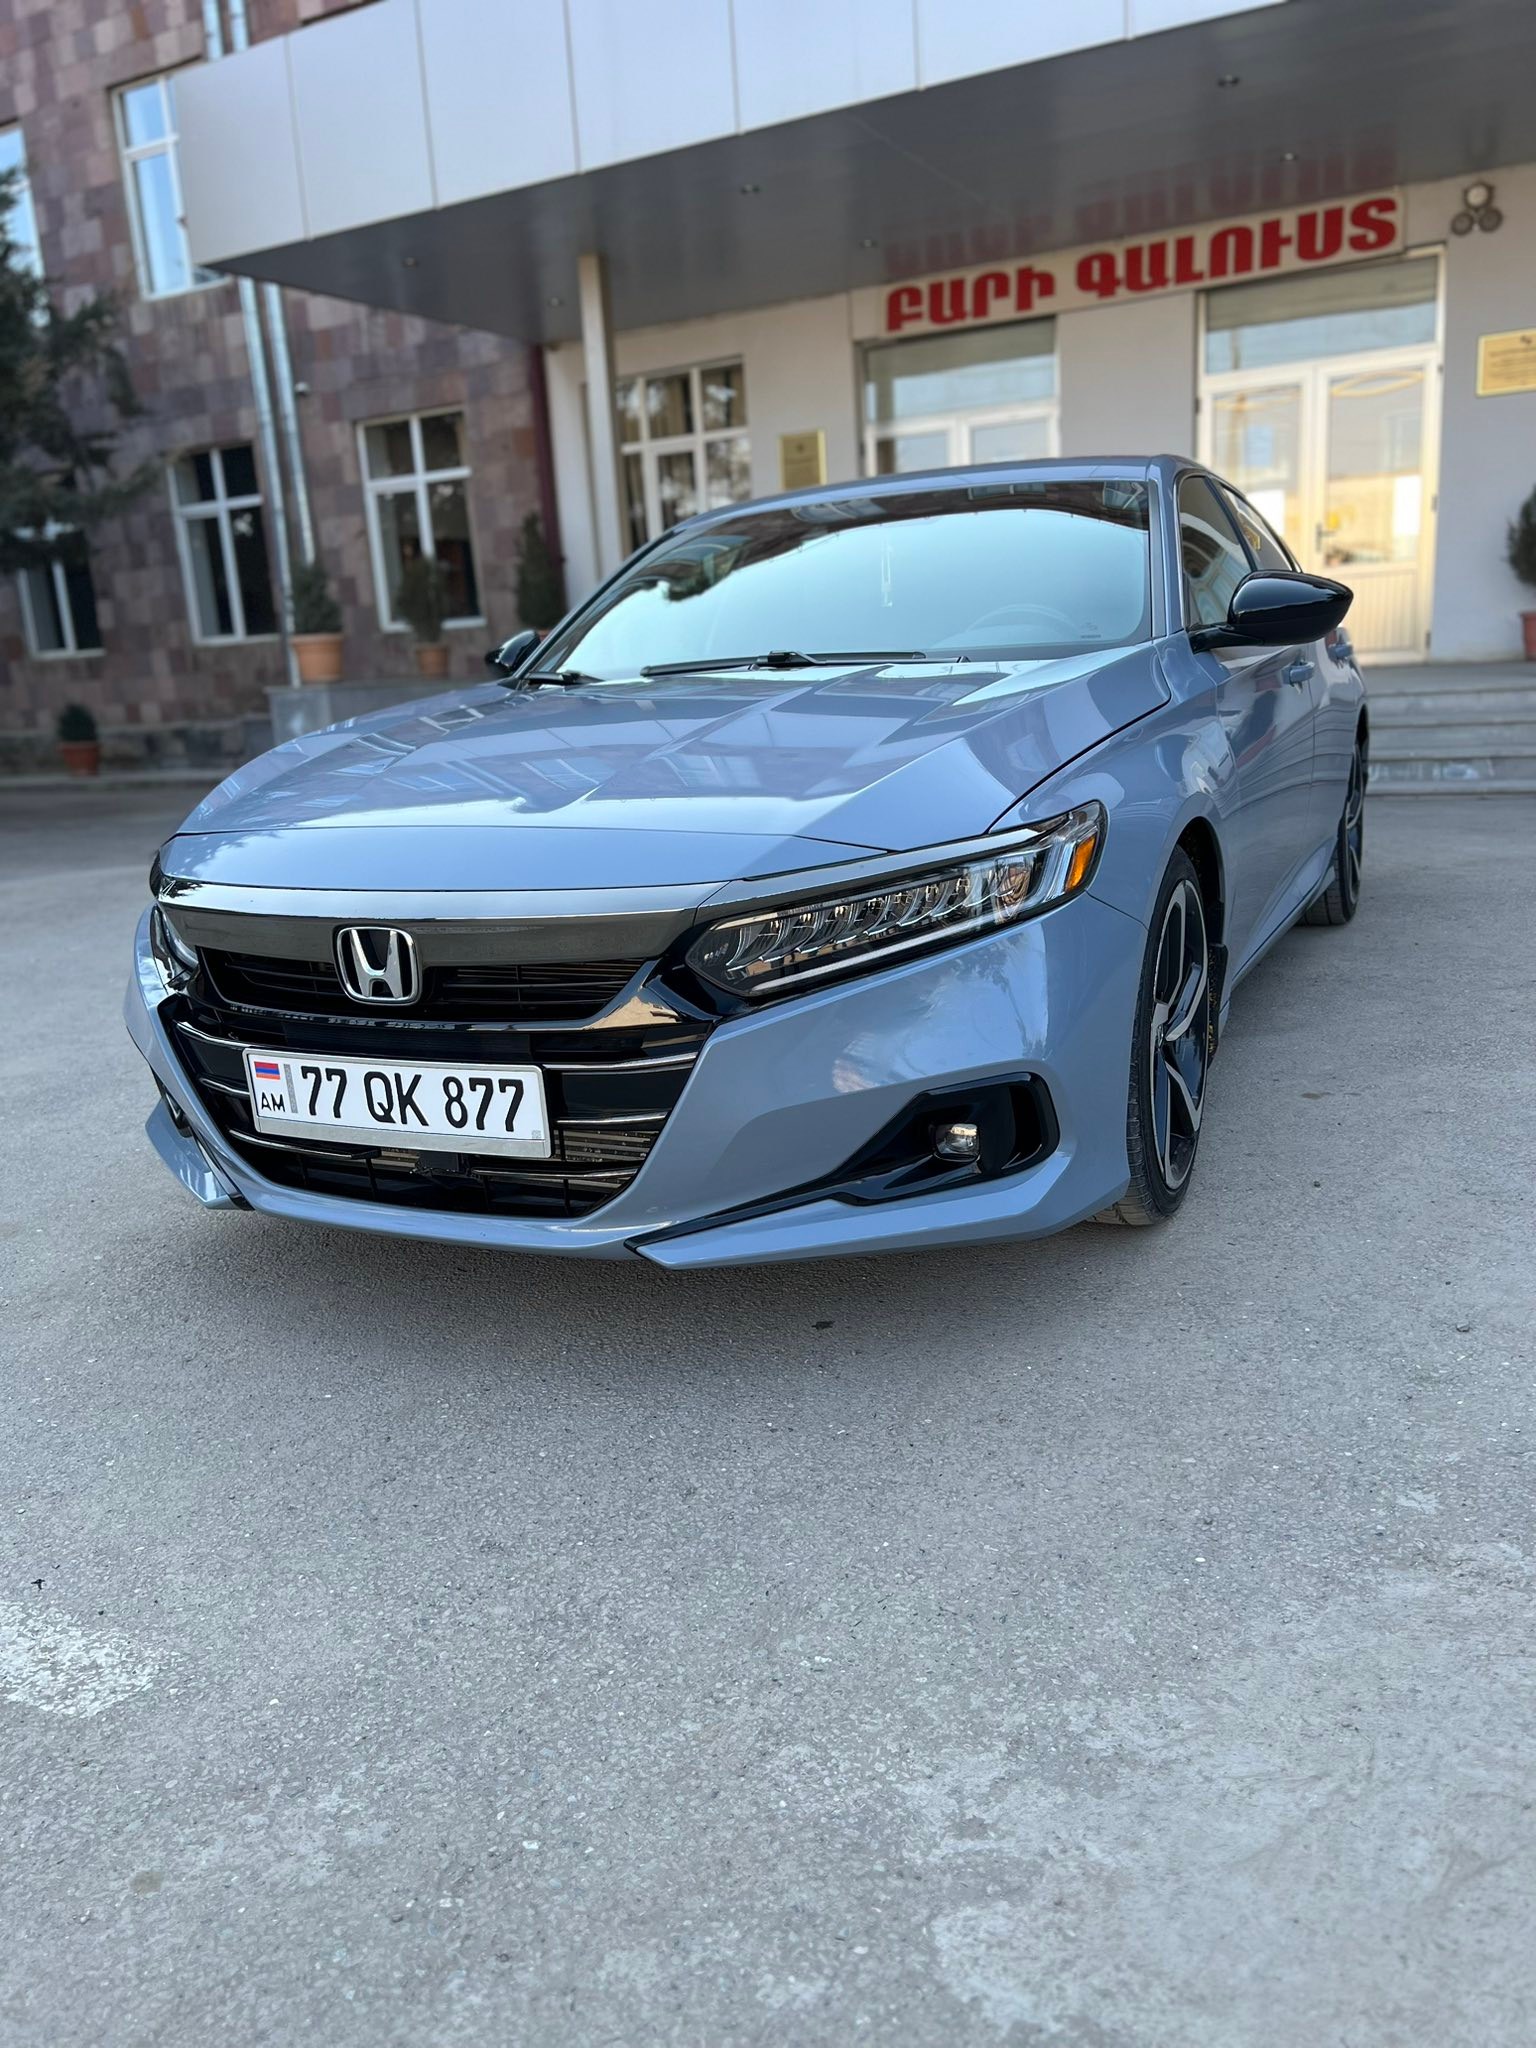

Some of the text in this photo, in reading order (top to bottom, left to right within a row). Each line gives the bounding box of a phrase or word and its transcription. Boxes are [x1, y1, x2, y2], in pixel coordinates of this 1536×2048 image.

[886, 198, 1398, 332] ԲԱՐԻ ԳԱԼՈՒՍՏ
[260, 1091, 286, 1113] AM
[300, 1065, 524, 1133] 77 QK 877
